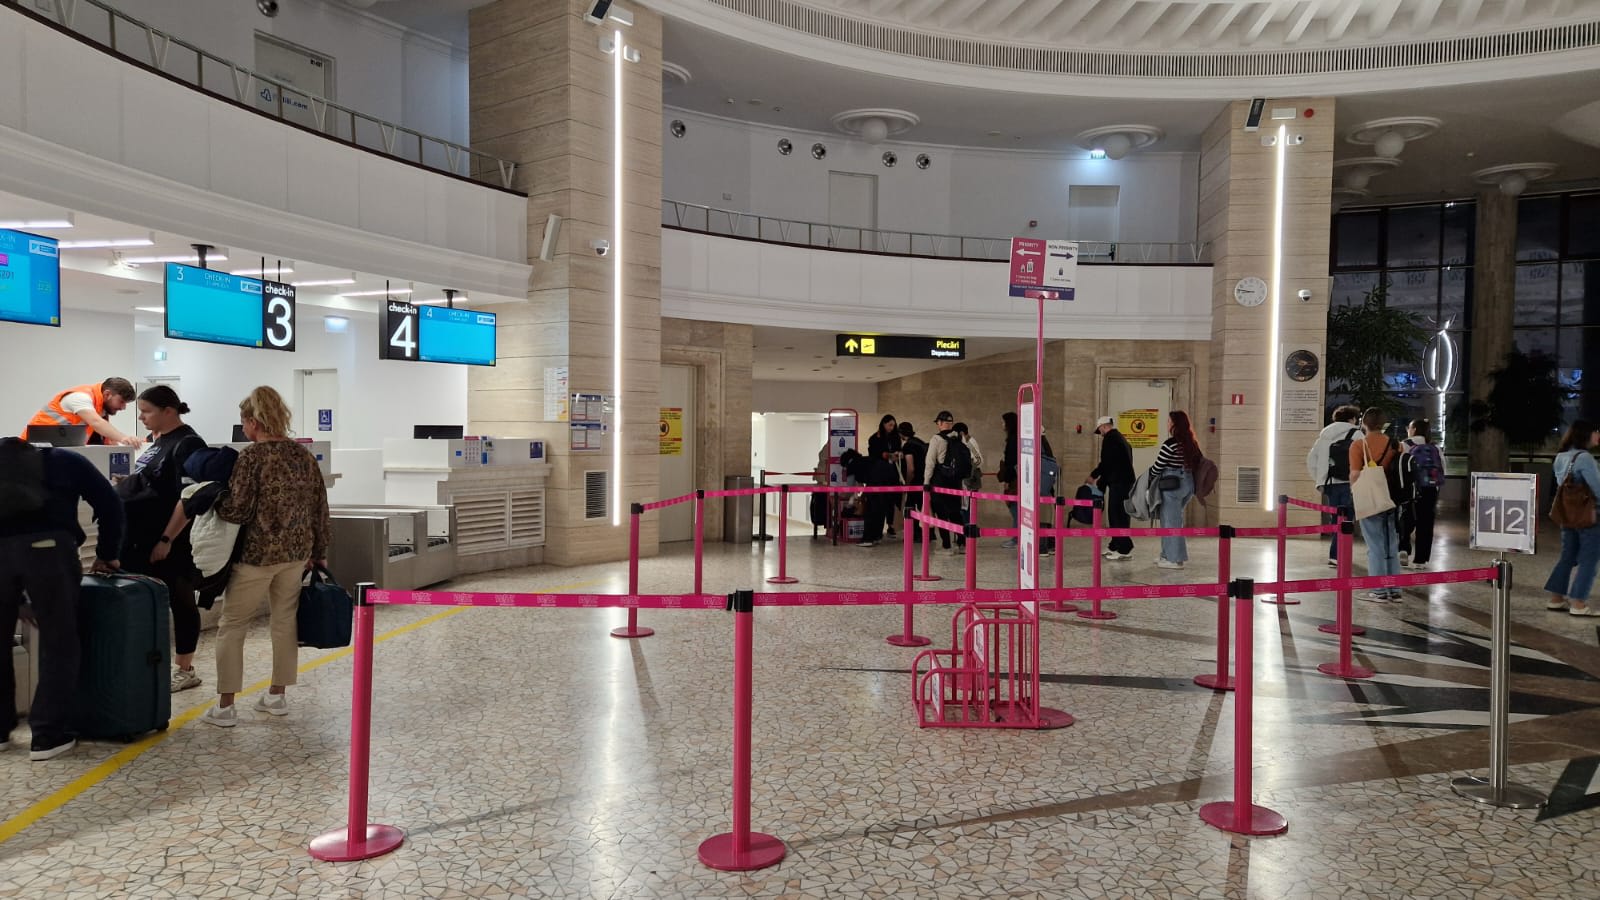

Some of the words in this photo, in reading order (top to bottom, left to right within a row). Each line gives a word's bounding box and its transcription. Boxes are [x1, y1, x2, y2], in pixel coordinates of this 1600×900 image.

[176, 266, 184, 281] 3
[204, 273, 231, 283] CHECK-IN
[265, 284, 294, 297] check-in
[388, 302, 417, 315] check-in
[426, 308, 433, 318] 4
[266, 296, 293, 347] 3
[390, 315, 417, 357] 4
